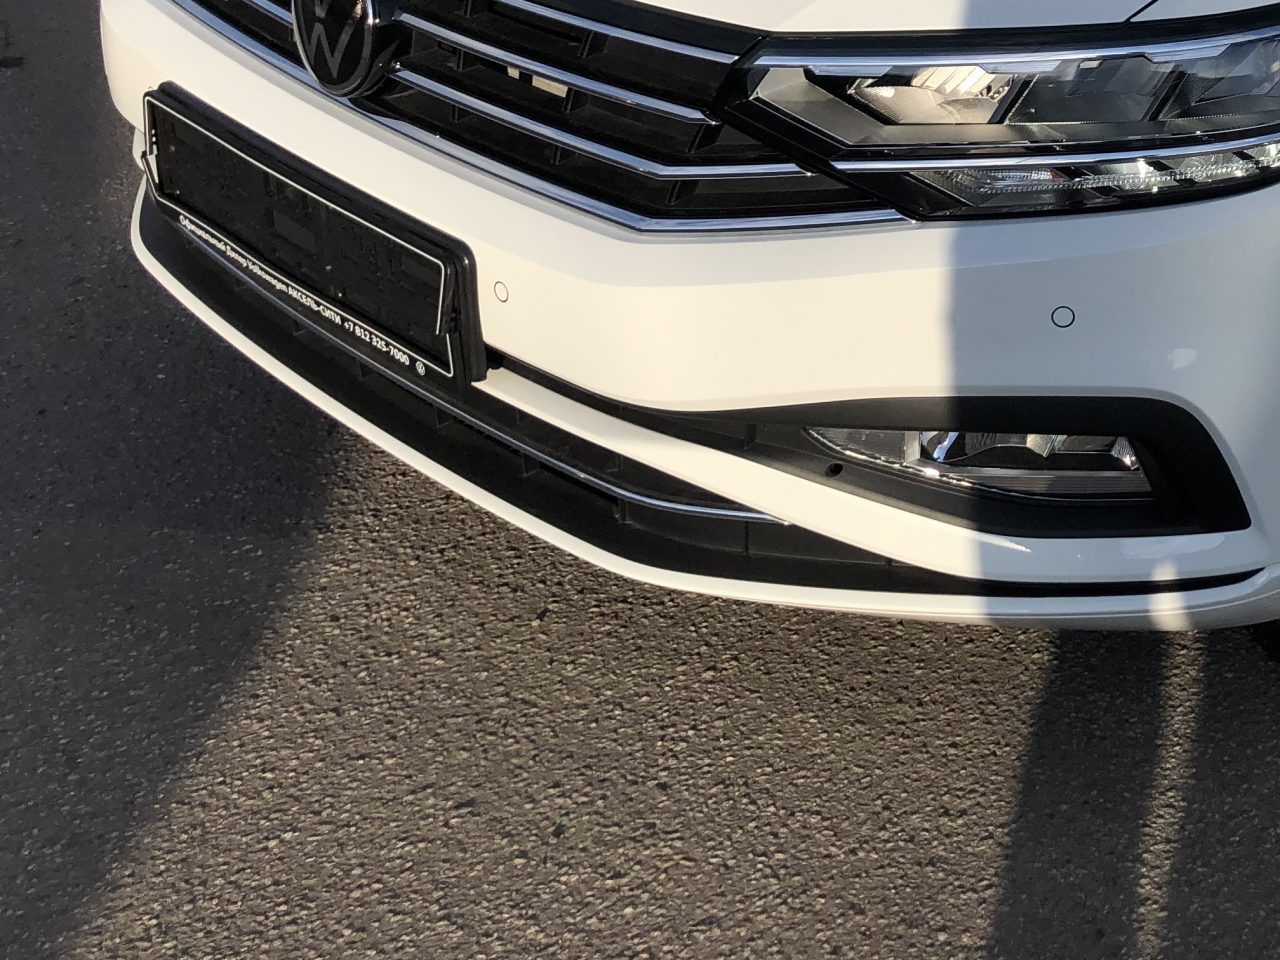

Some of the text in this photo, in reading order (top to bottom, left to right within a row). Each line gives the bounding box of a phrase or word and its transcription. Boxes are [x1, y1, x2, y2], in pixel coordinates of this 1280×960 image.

[343, 321, 354, 332] +7
[355, 326, 371, 343] 812
[371, 334, 410, 366] 325-7000
